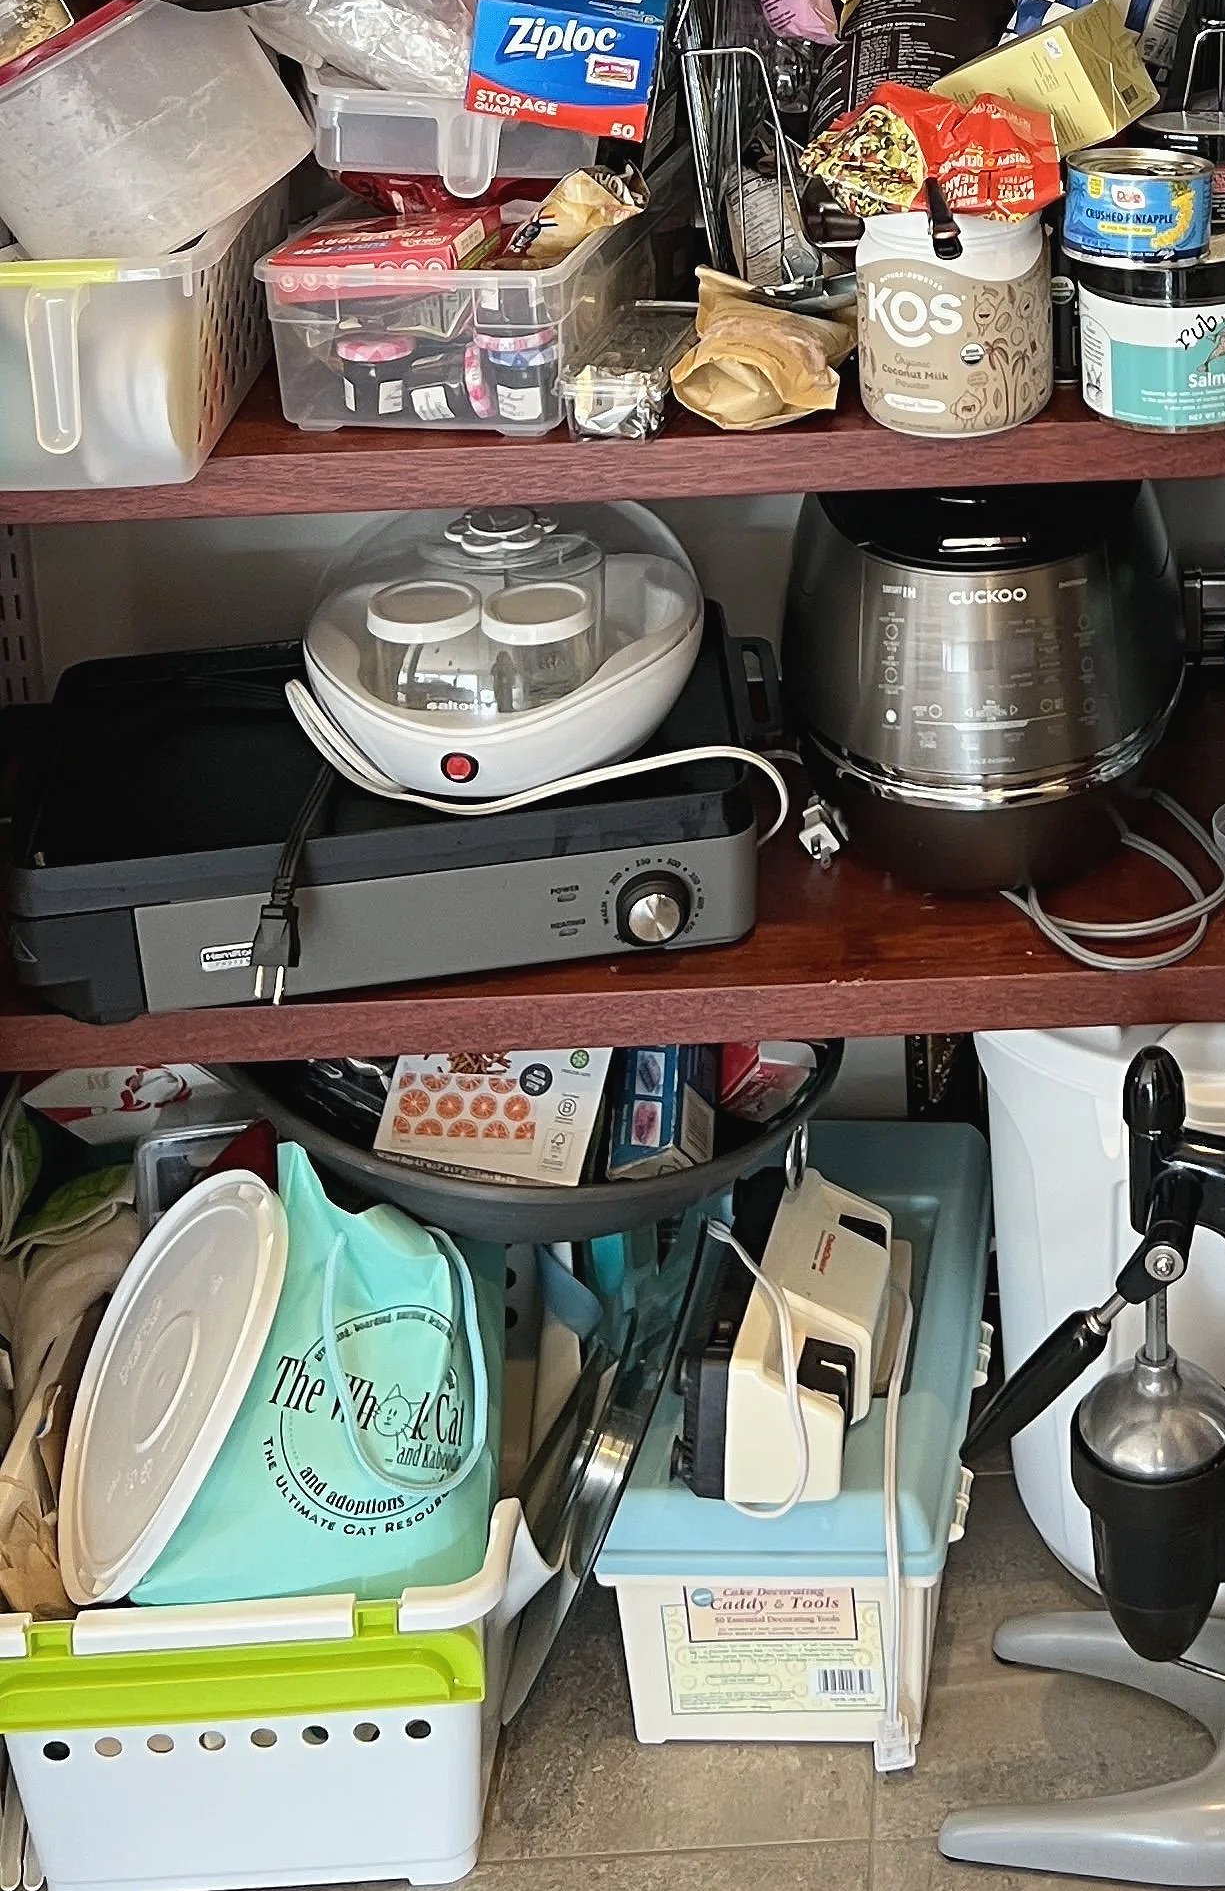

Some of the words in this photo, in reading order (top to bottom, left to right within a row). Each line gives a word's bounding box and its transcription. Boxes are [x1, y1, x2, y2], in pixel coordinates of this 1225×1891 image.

[504, 17, 618, 60] Ziploc
[474, 101, 519, 117] QUART
[475, 90, 559, 116] STORAGE
[610, 123, 636, 139] 50
[1085, 208, 1124, 224] CRUSHED
[1125, 211, 1174, 224] PINEAPPLE
[868, 282, 964, 348] KOS
[1175, 312, 1218, 351] rub
[882, 364, 922, 380] Coconut
[924, 371, 949, 381] Milk
[902, 586, 917, 600] IH
[949, 586, 1028, 606] CUCKOO
[550, 884, 580, 895] POWER
[268, 1355, 326, 1414] The
[436, 1393, 465, 1447] Cat
[262, 1436, 277, 1471] THE
[275, 1474, 335, 1532] ULTIMATE
[343, 1522, 377, 1537] CAT
[299, 1465, 329, 1497] and
[325, 1490, 406, 1516] adoptions
[711, 1597, 769, 1614] Caddy
[791, 1596, 840, 1609] Tools
[727, 1615, 765, 1624] Essential
[817, 1615, 841, 1624] Tools
